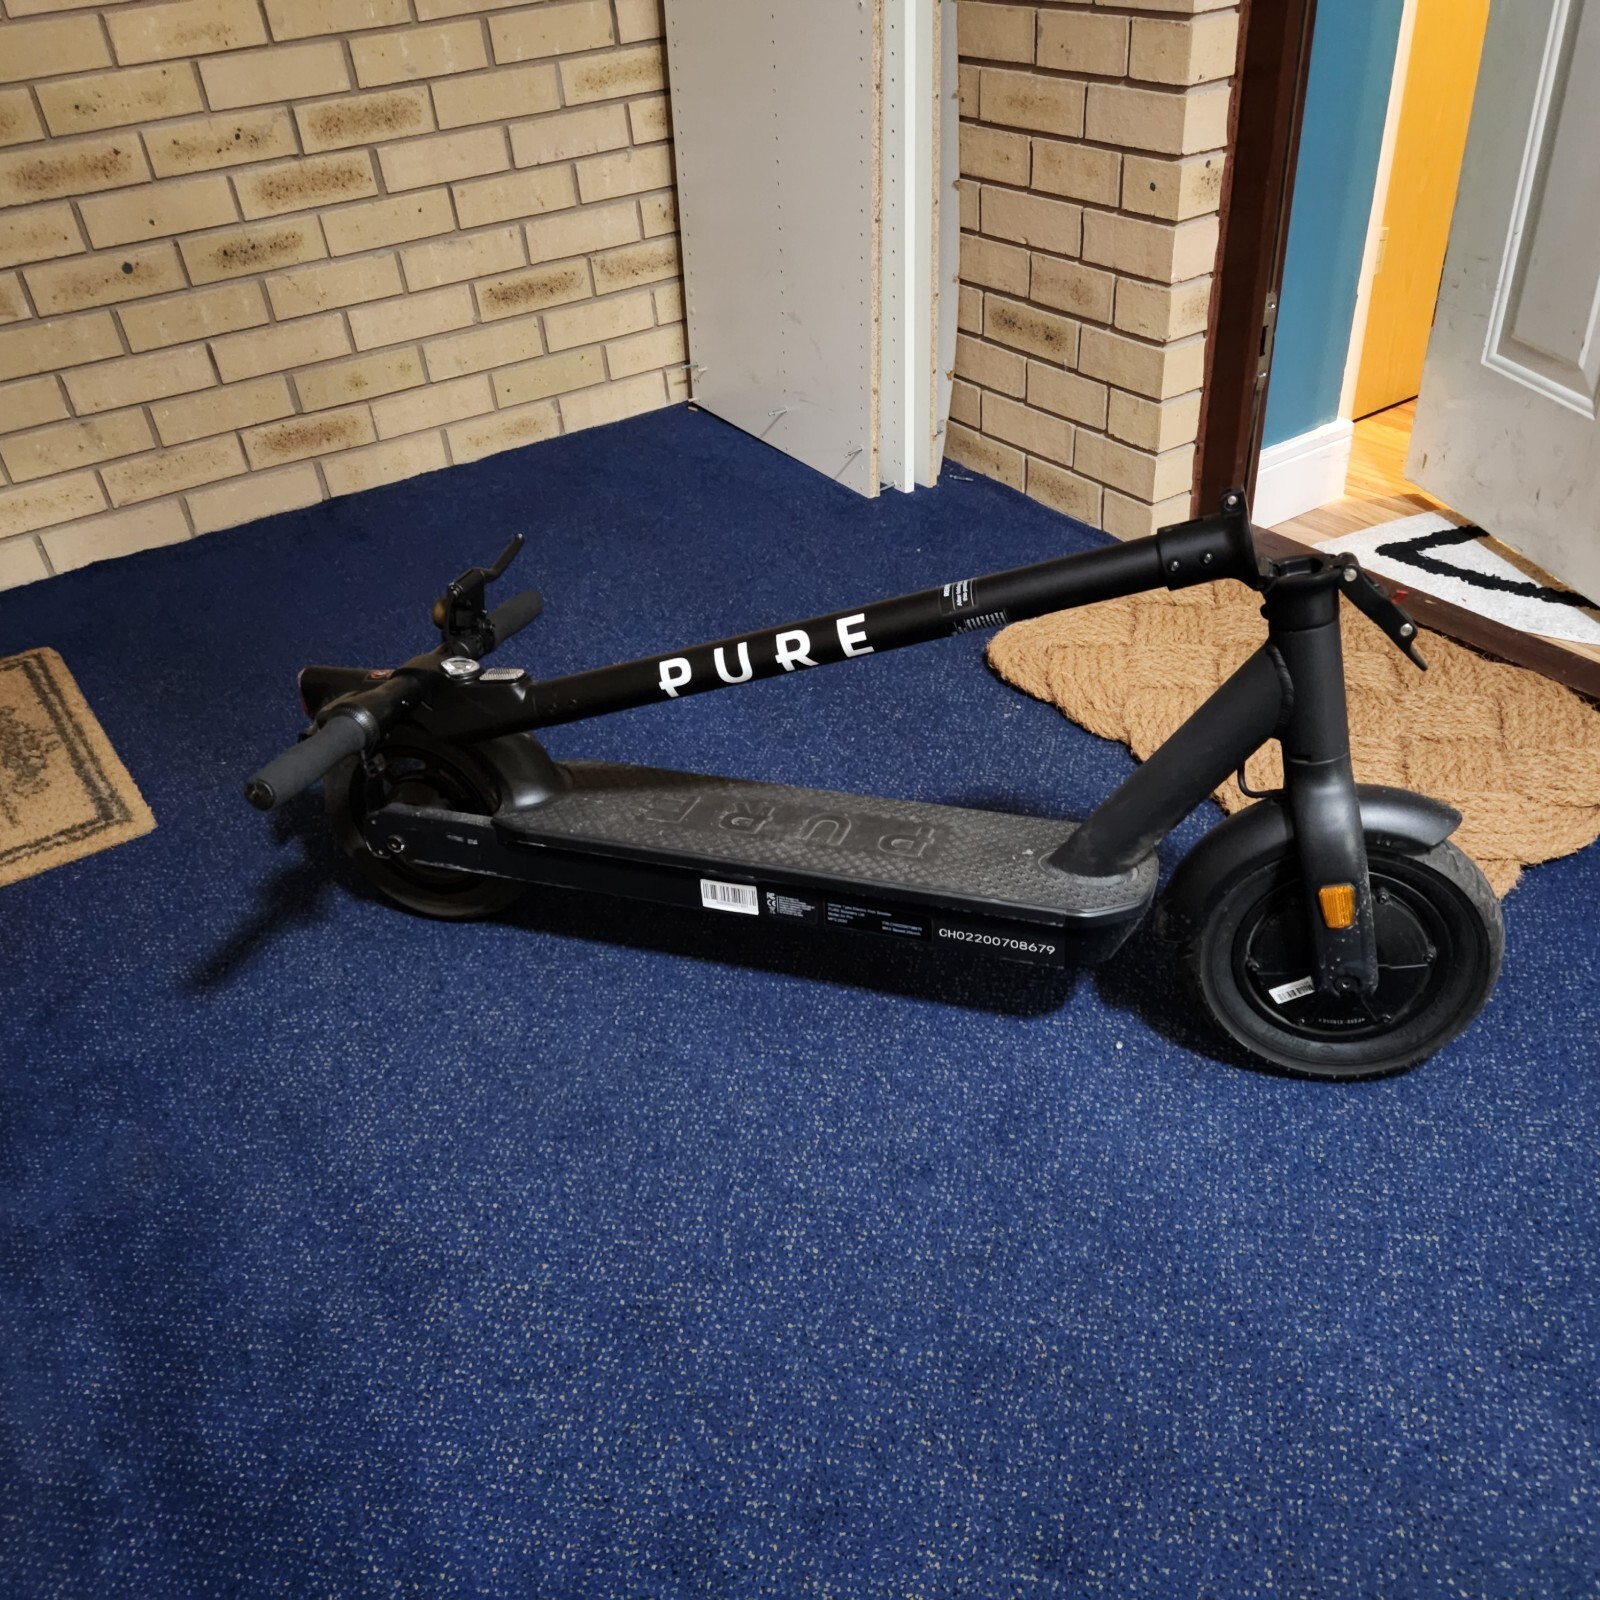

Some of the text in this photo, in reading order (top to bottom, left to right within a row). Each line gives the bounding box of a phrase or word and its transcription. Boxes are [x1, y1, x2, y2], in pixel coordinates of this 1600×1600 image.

[657, 613, 875, 698] PURE
[643, 796, 936, 858] PURE
[938, 928, 1056, 955] CH02200708679
